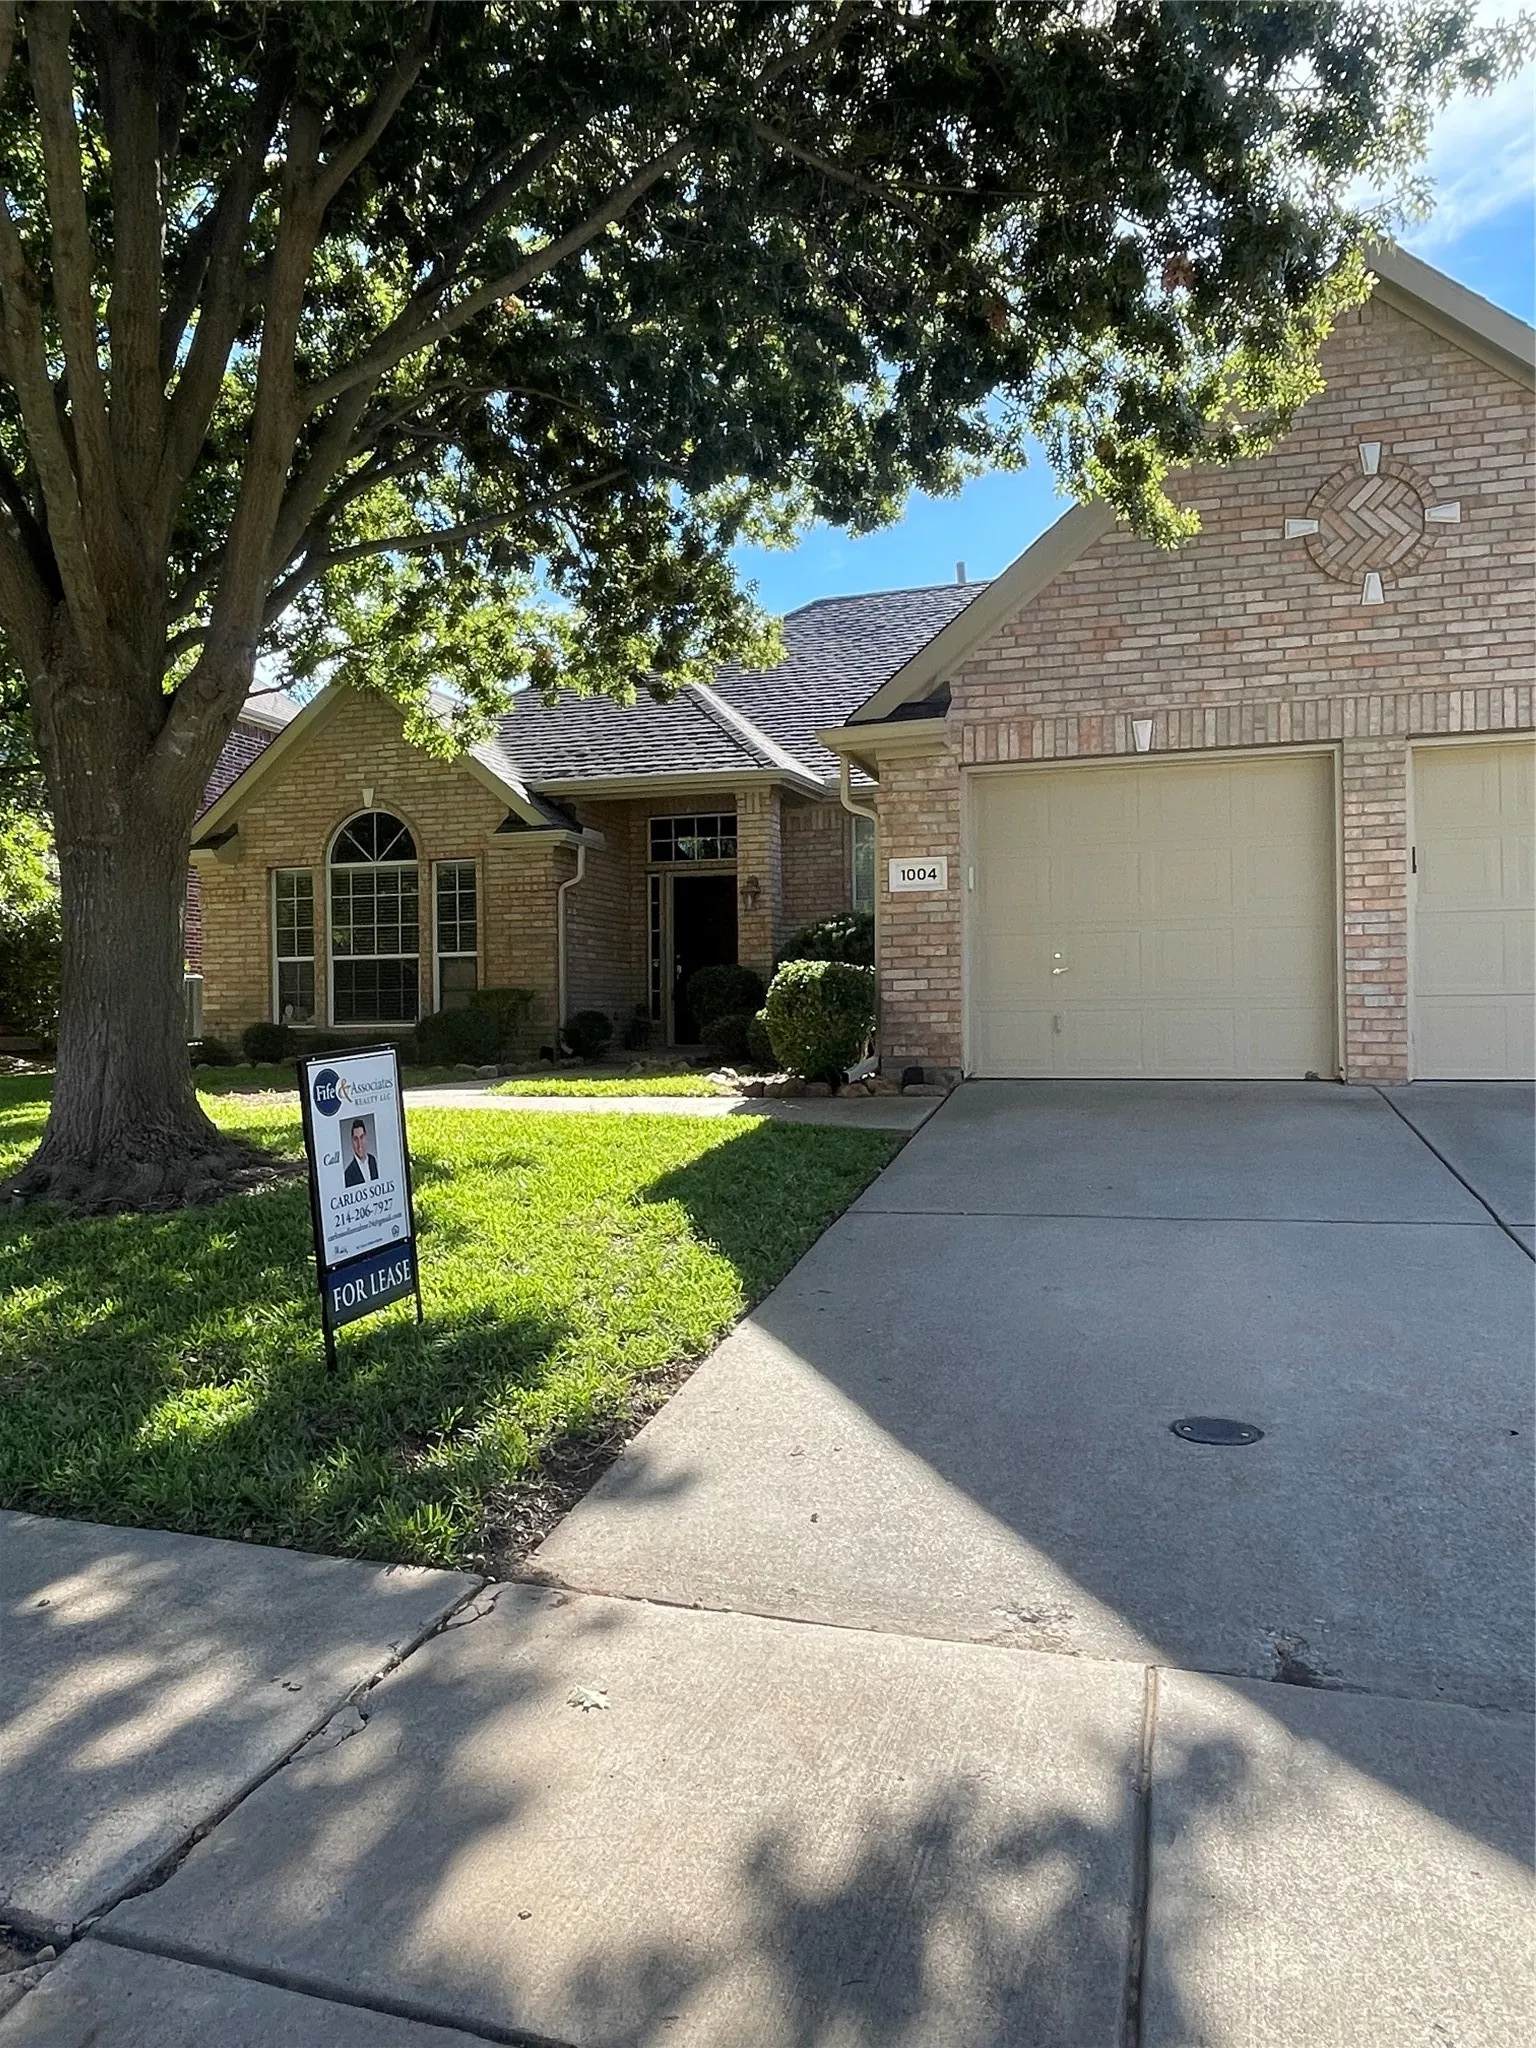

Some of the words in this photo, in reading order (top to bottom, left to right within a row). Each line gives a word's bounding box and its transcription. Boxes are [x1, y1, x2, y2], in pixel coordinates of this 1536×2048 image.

[901, 868, 937, 881] 1004
[315, 1083, 336, 1102] Fife
[338, 1078, 353, 1103] &
[351, 1078, 394, 1096] Associates
[355, 1095, 378, 1107] REALTY
[379, 1092, 392, 1101] LLC
[323, 1151, 340, 1167] Call
[330, 1188, 368, 1210] CARLOS
[369, 1180, 396, 1197] SOLIS
[335, 1198, 393, 1227] 214-206-7927
[333, 1278, 368, 1312] FOR
[370, 1259, 412, 1296] LEASE
